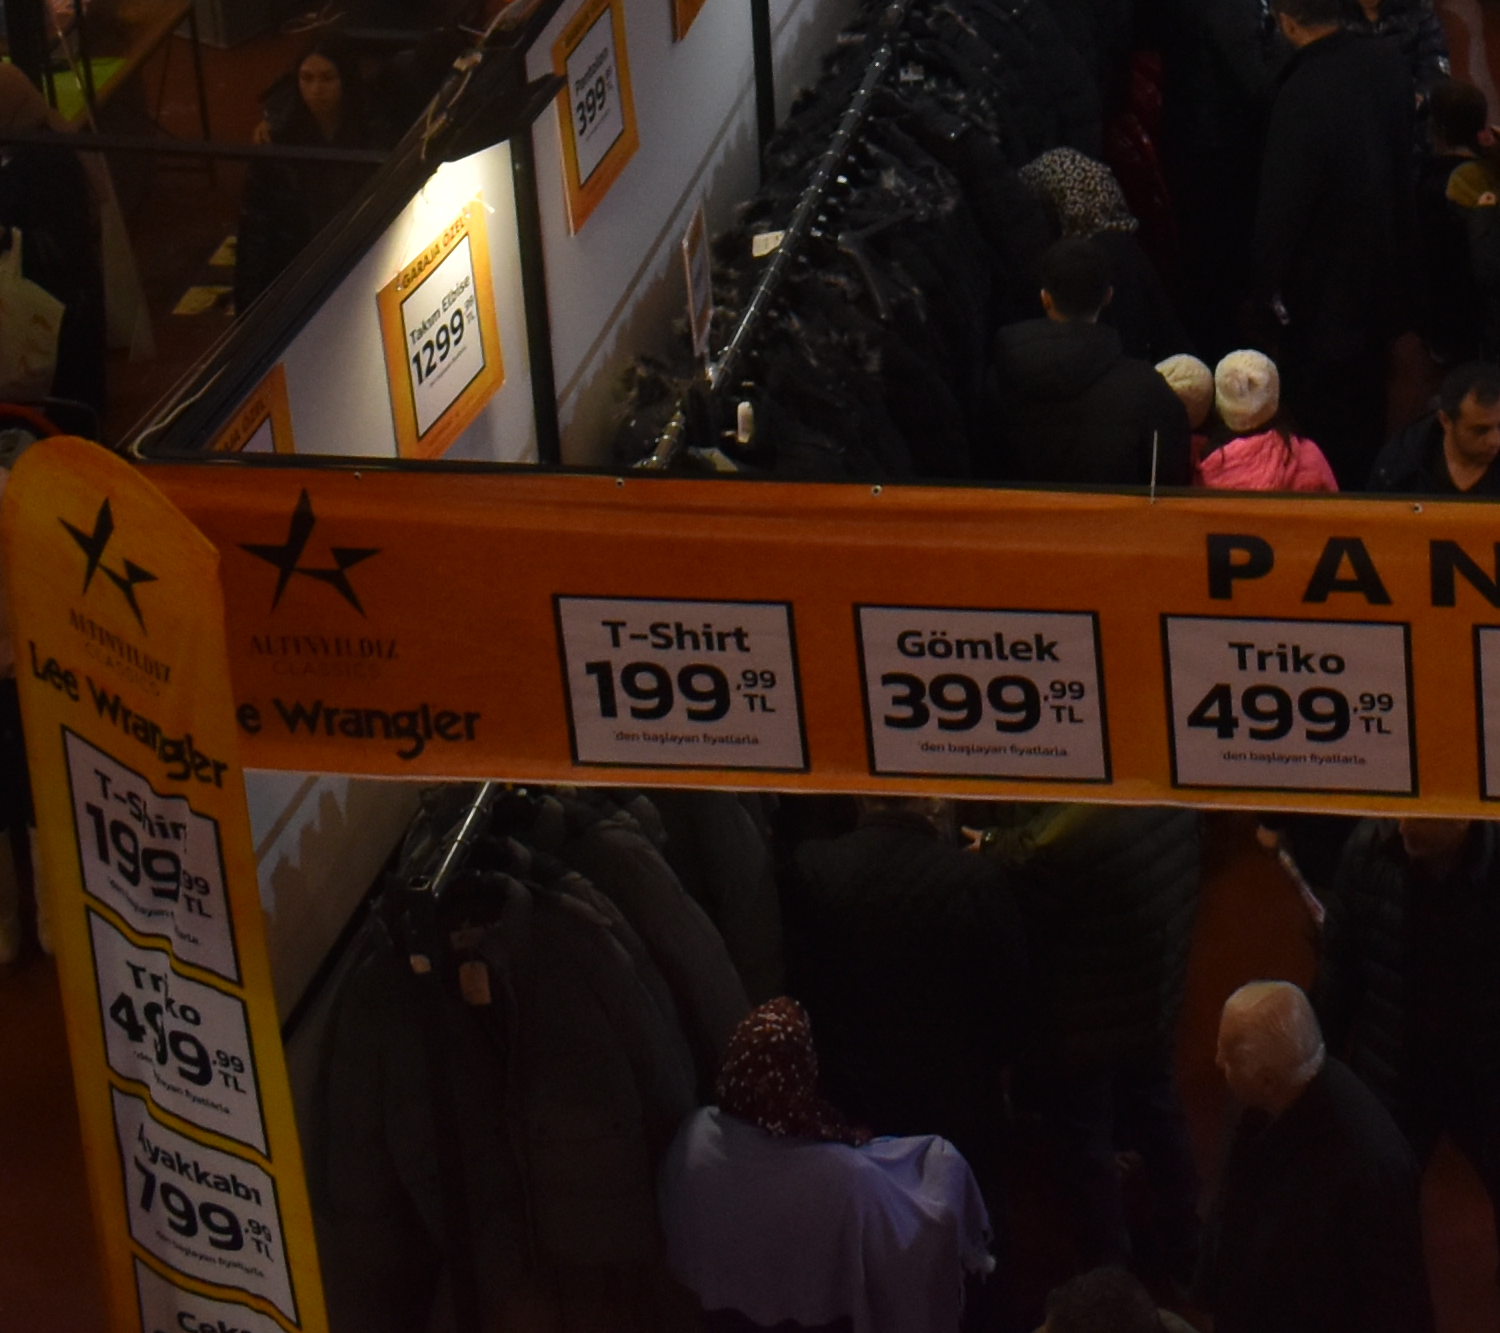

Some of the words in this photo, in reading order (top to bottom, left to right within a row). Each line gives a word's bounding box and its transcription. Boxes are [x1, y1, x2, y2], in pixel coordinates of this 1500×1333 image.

[601, 619, 750, 652] T-Shirt
[897, 630, 1059, 661] Gömlek
[1229, 643, 1346, 675] Triko
[29, 642, 78, 701] Lee
[87, 676, 227, 788] Wrangler
[743, 693, 776, 713] TL
[1051, 705, 1084, 723] TL
[273, 698, 480, 760] Wrangler
[1359, 715, 1391, 734] TL
[184, 894, 212, 918] TL
[217, 1070, 246, 1094] TL
